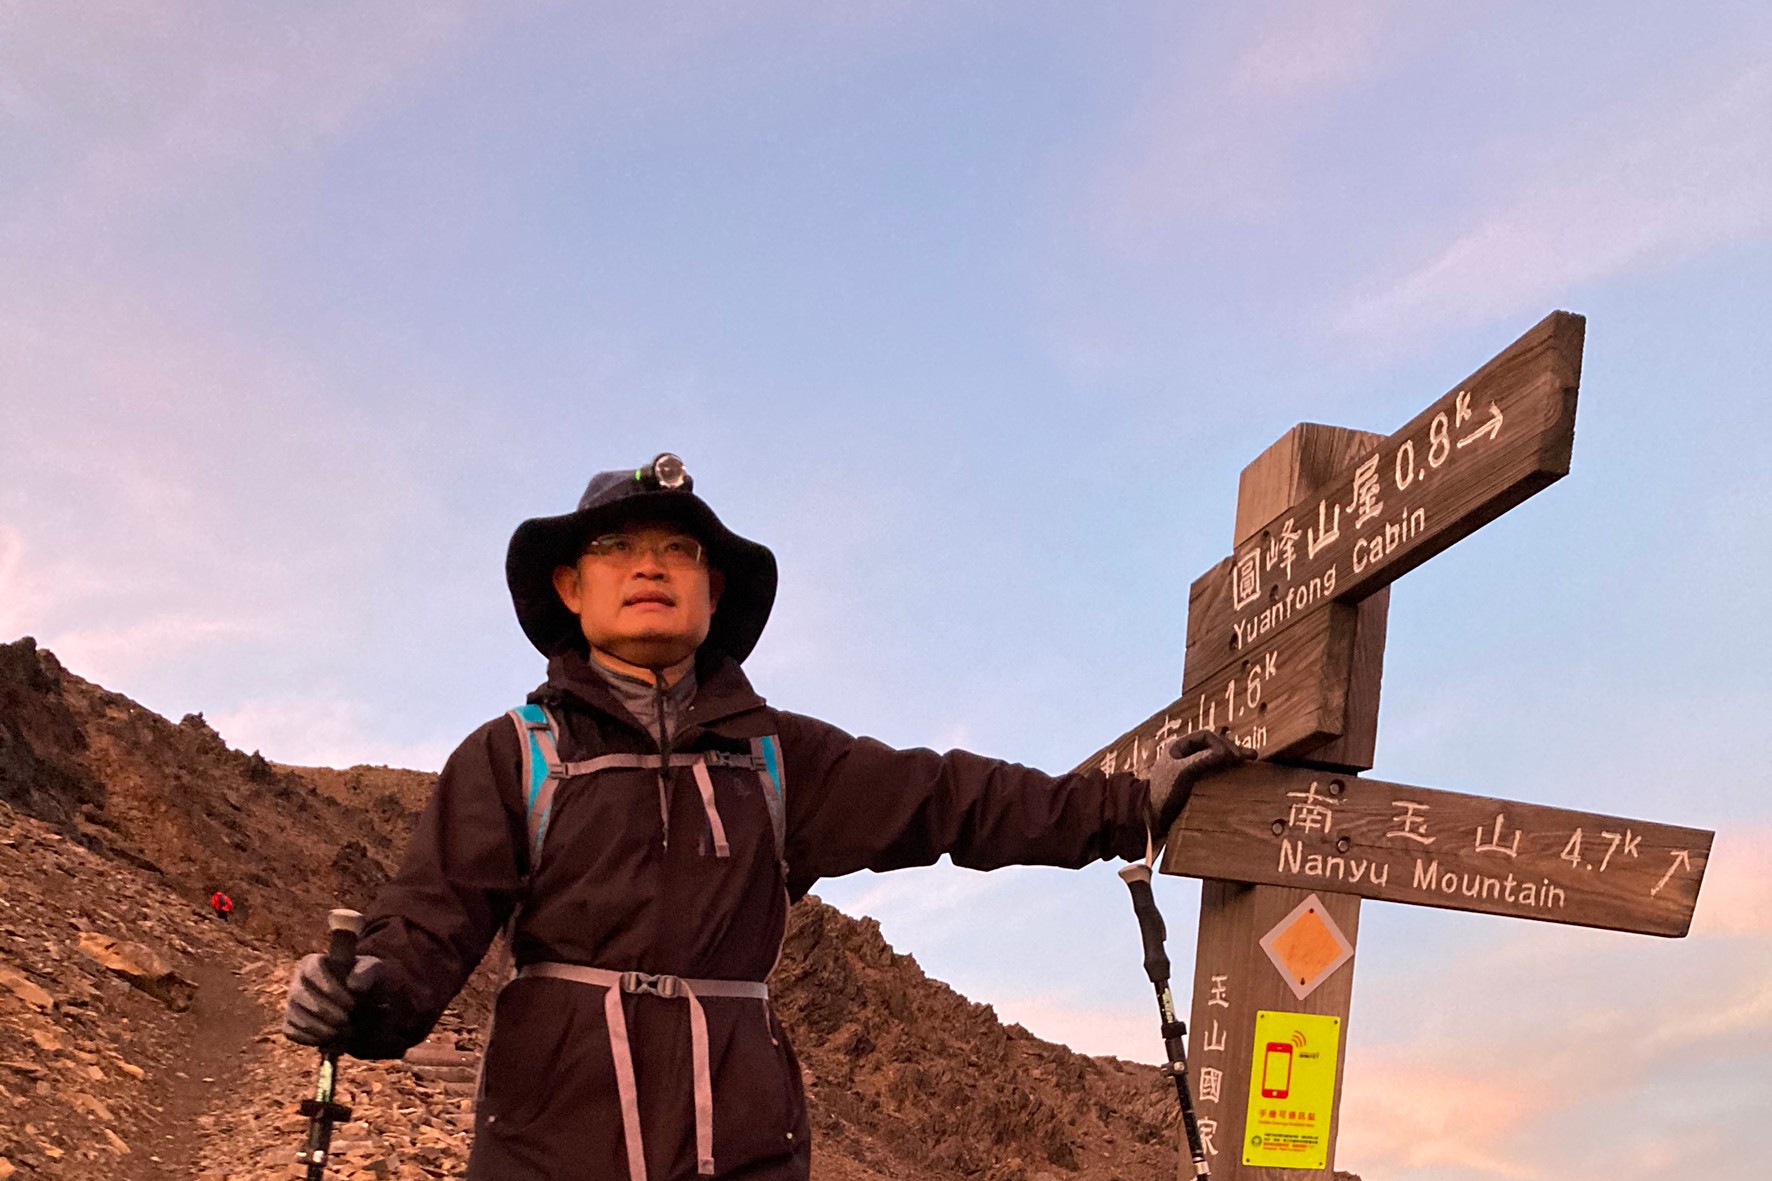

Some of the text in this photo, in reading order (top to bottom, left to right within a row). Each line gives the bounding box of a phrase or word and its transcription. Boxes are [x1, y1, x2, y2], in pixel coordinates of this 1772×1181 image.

[1232, 452, 1384, 612] 圓峰山屋
[1233, 506, 1426, 650] Yuanfong Cabin
[1277, 838, 1566, 909] Nanyu Mountain
[1286, 781, 1522, 858] 南玉山
